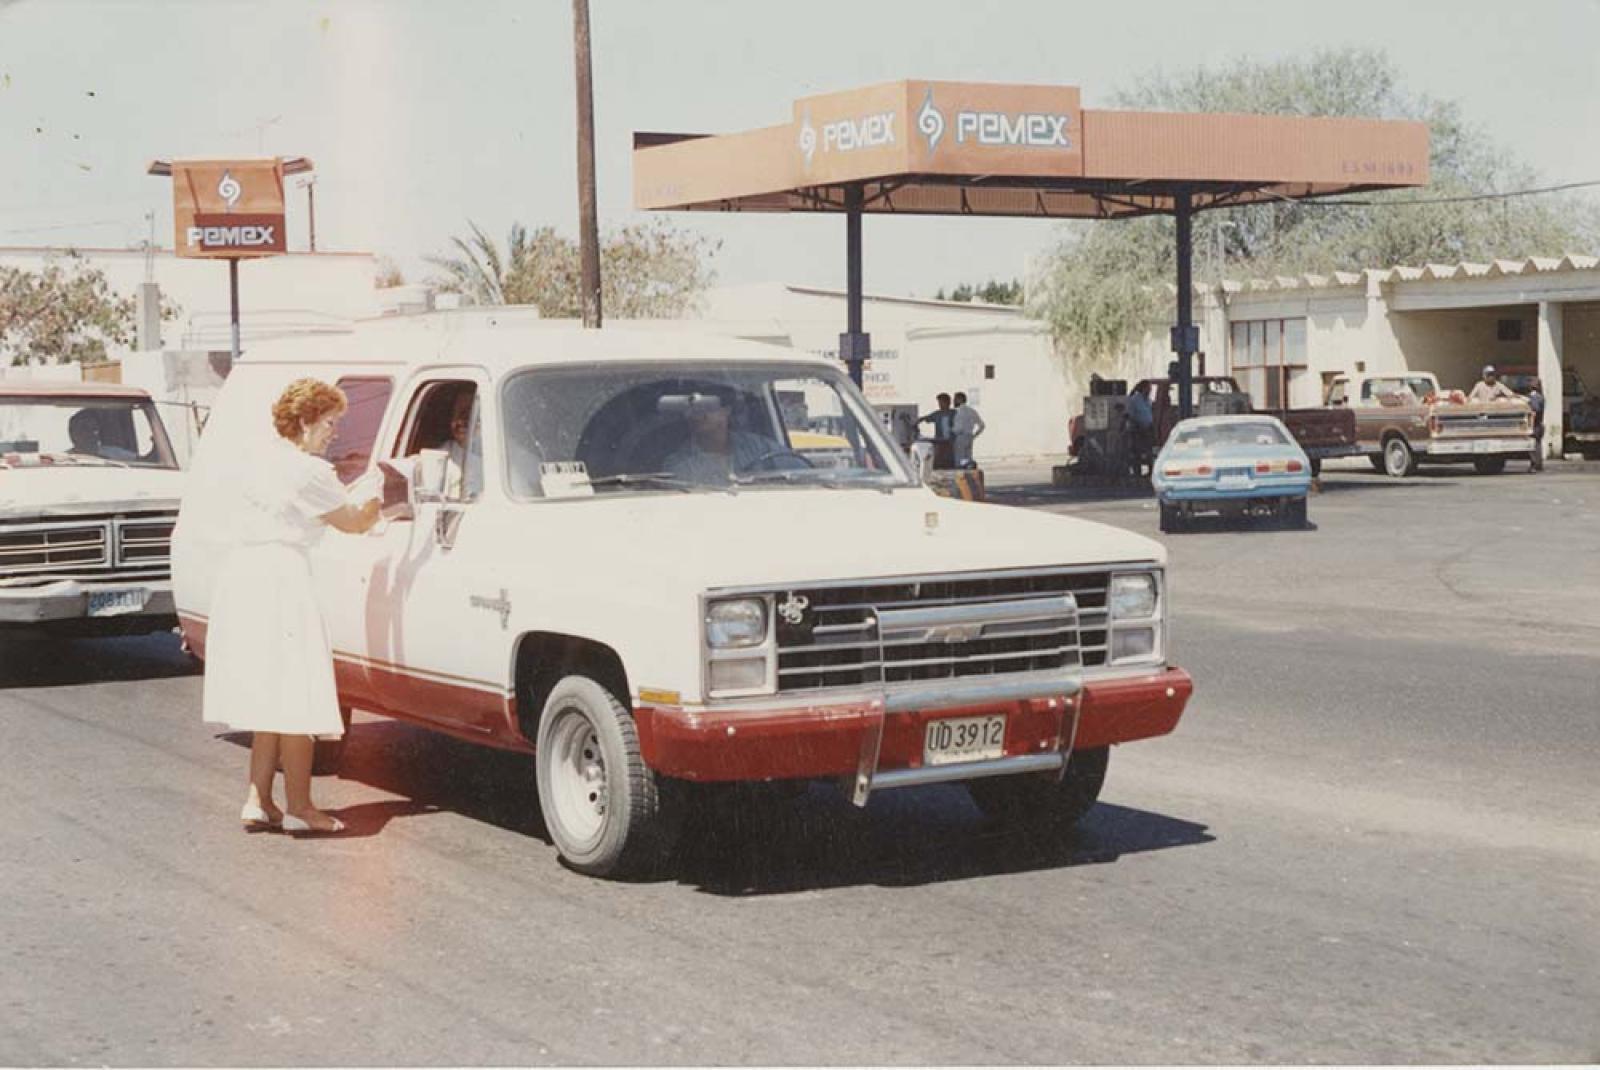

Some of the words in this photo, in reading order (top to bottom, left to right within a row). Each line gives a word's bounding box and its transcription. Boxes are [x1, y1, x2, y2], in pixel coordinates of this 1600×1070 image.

[822, 111, 896, 152] PEMEX
[956, 111, 1070, 147] PEMEX
[186, 225, 275, 249] PEMEX
[927, 723, 953, 752] UD
[955, 720, 1004, 749] 3912
